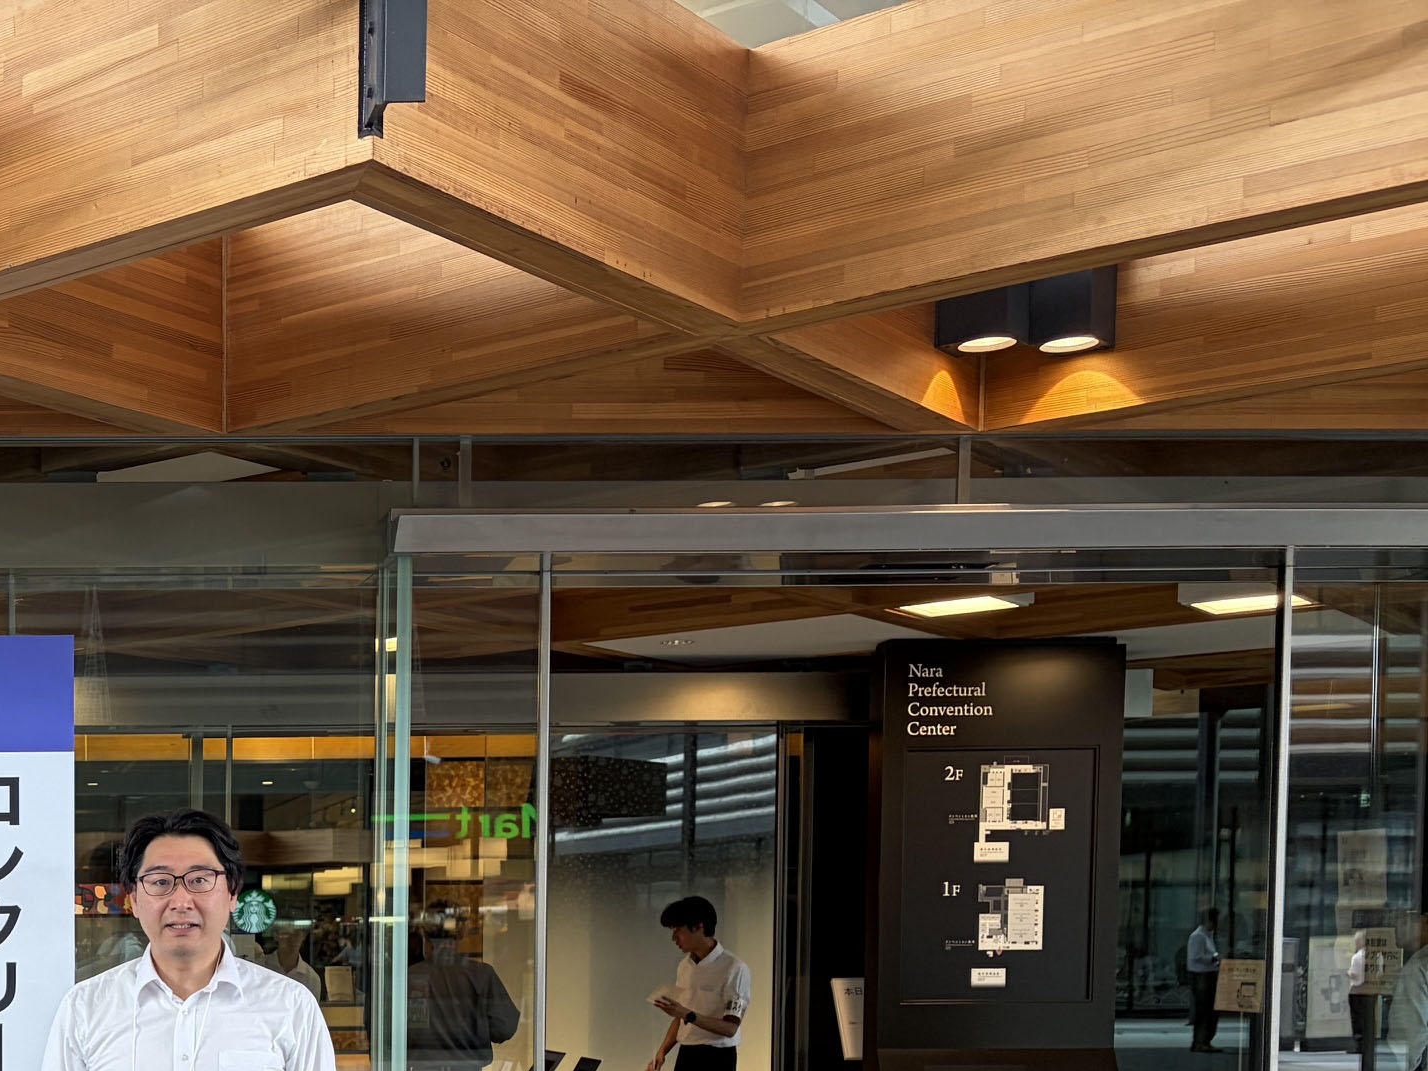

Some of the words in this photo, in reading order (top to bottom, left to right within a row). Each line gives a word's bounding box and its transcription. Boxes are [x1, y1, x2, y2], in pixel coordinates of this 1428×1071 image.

[908, 663, 943, 678] Nara
[908, 681, 986, 697] Prefectural
[907, 702, 993, 717] Convention
[907, 721, 957, 736] Center
[944, 765, 964, 781] 2F
[942, 881, 961, 897] 1F
